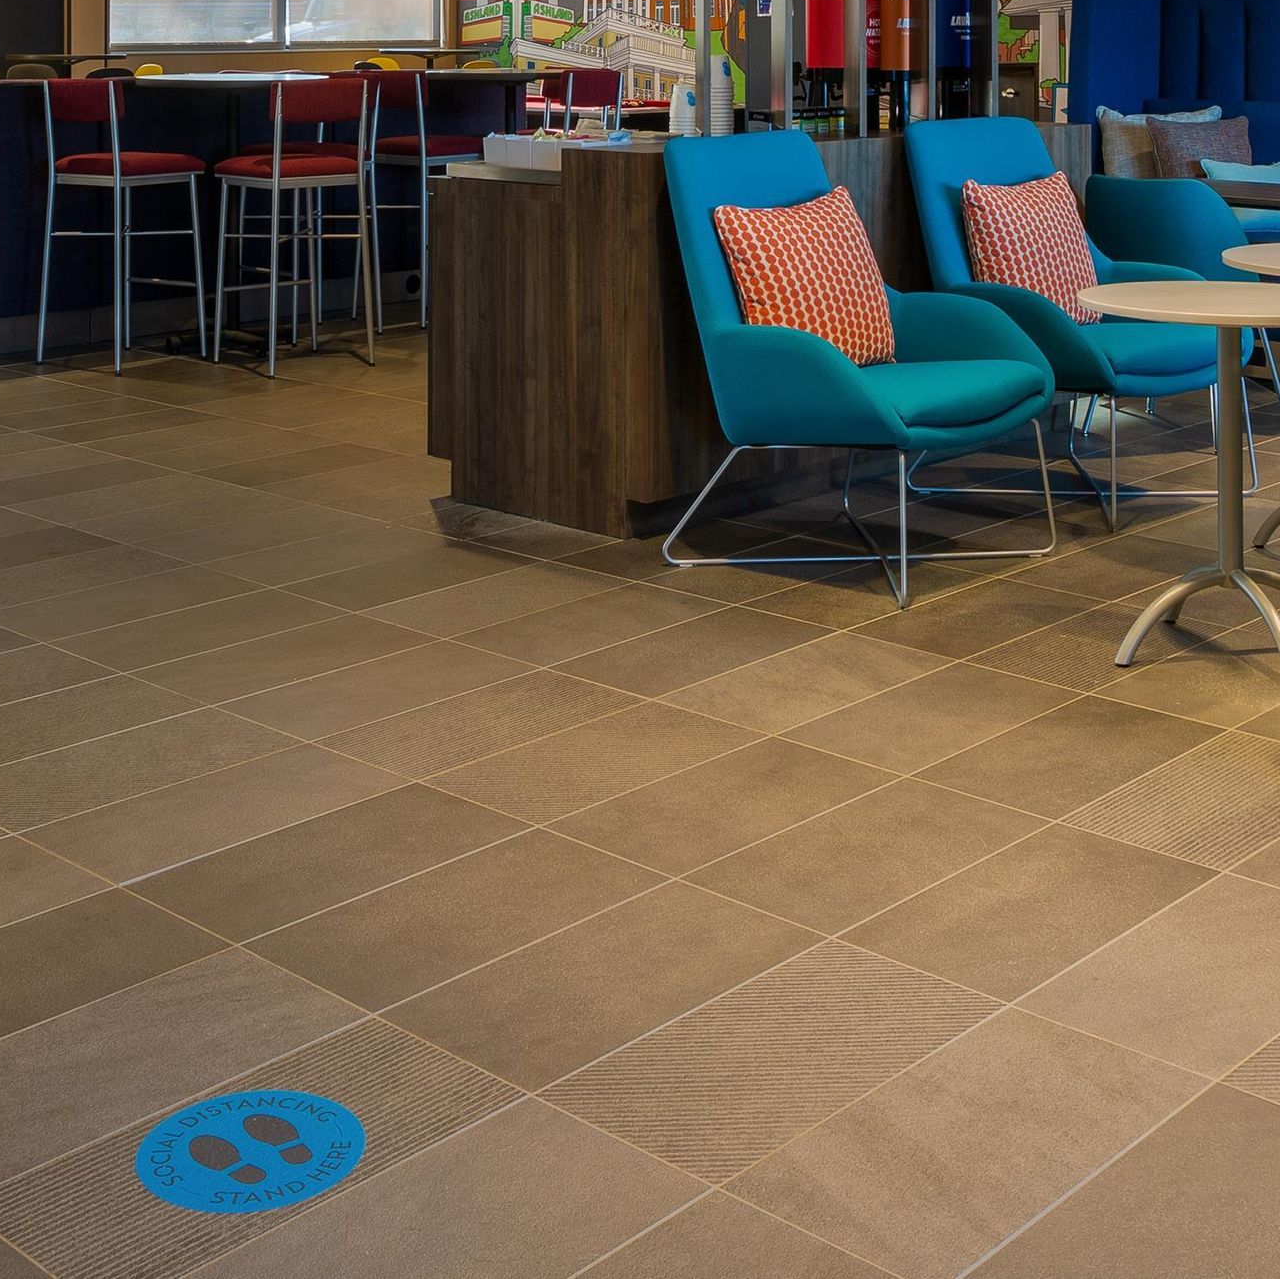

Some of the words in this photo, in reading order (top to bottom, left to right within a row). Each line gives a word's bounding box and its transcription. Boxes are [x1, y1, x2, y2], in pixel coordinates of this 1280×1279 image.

[464, 3, 501, 22] ASHLAND
[533, 3, 573, 21] ASHLAND
[150, 1131, 184, 1188] SOCIAL
[178, 1096, 338, 1129] DISTANCING
[209, 1180, 307, 1205] STAND
[307, 1140, 352, 1183] HERE
